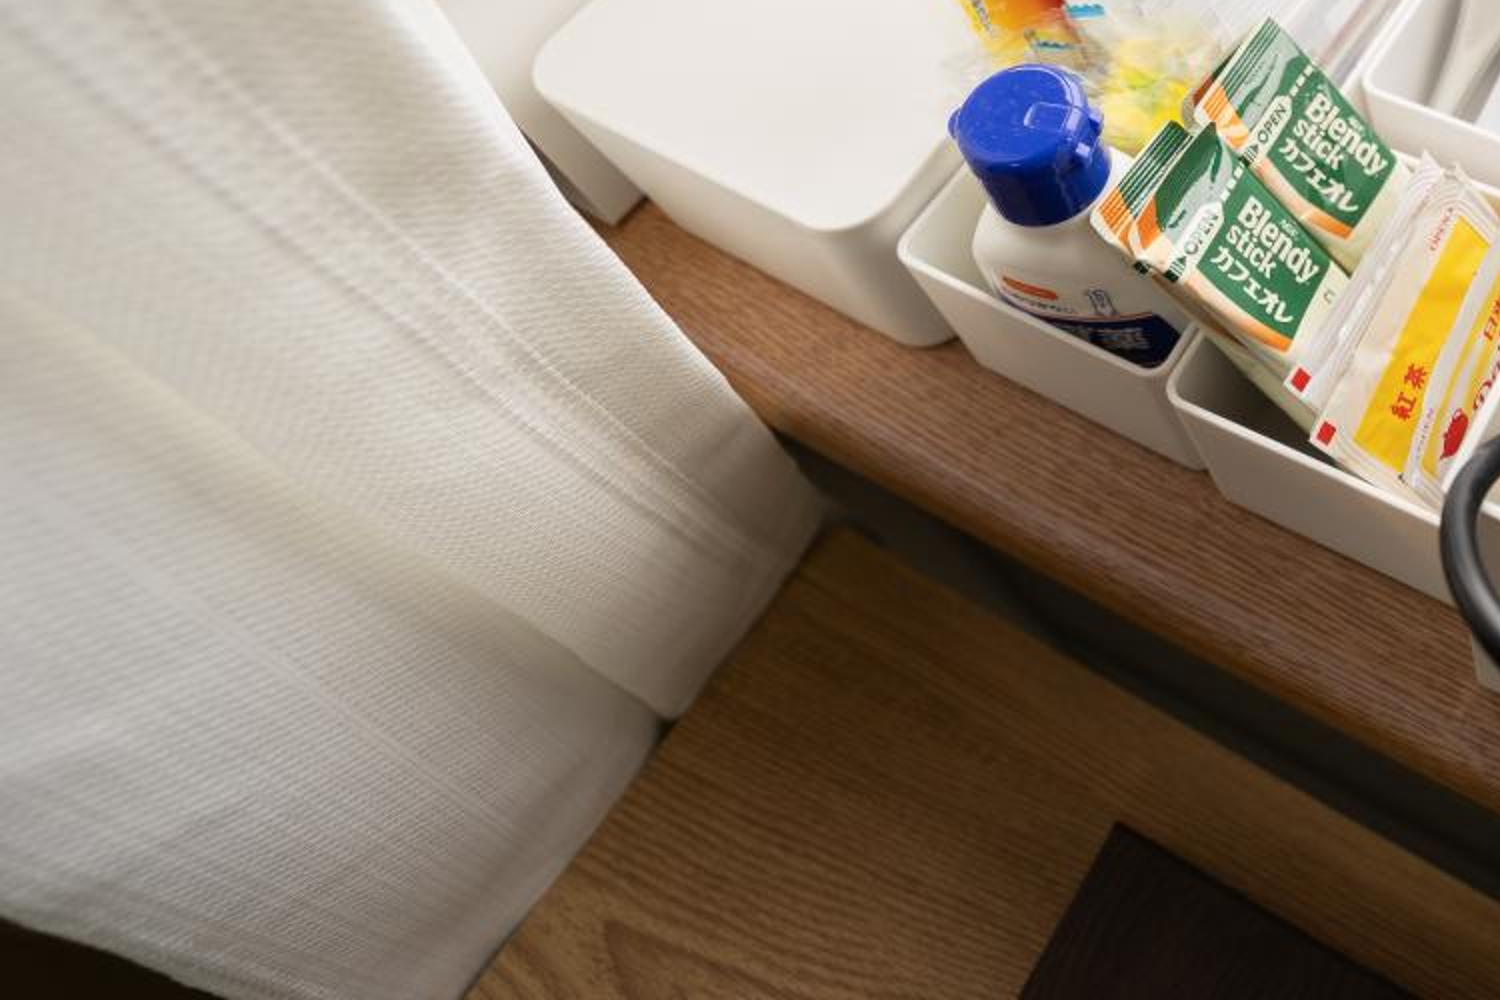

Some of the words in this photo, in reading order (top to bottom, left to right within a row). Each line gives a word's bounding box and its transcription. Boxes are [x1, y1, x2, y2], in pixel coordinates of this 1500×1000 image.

[1257, 104, 1287, 142] OPEN
[1294, 120, 1344, 169] stick
[1305, 92, 1388, 176] Blendy
[1279, 138, 1359, 211] カフェオレ
[1225, 226, 1276, 279] stick
[1237, 196, 1320, 284] Blendy
[1211, 247, 1293, 322] カフェオレ
[1391, 364, 1428, 421] 紅茶
